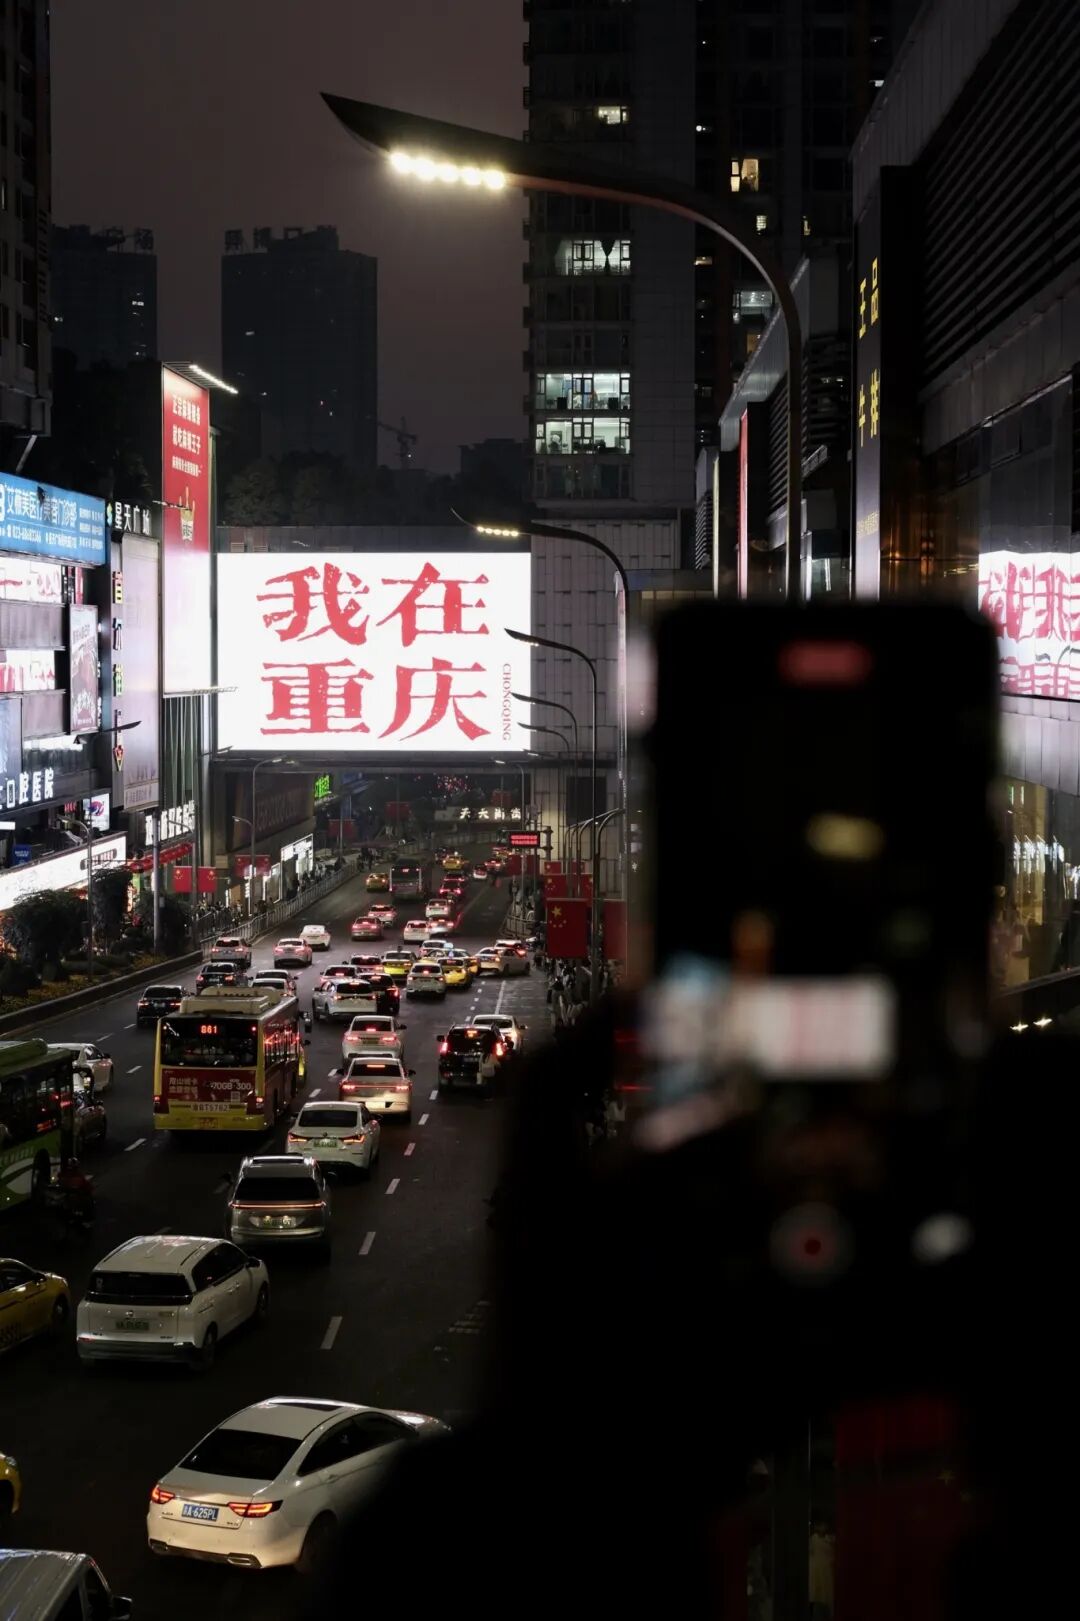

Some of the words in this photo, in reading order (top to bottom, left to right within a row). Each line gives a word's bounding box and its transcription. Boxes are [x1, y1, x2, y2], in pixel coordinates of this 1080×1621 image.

[256, 562, 489, 648] 我在
[260, 657, 490, 741] 重庆
[502, 663, 511, 740] CHONGQING
[0, 766, 54, 809] 口腔医院
